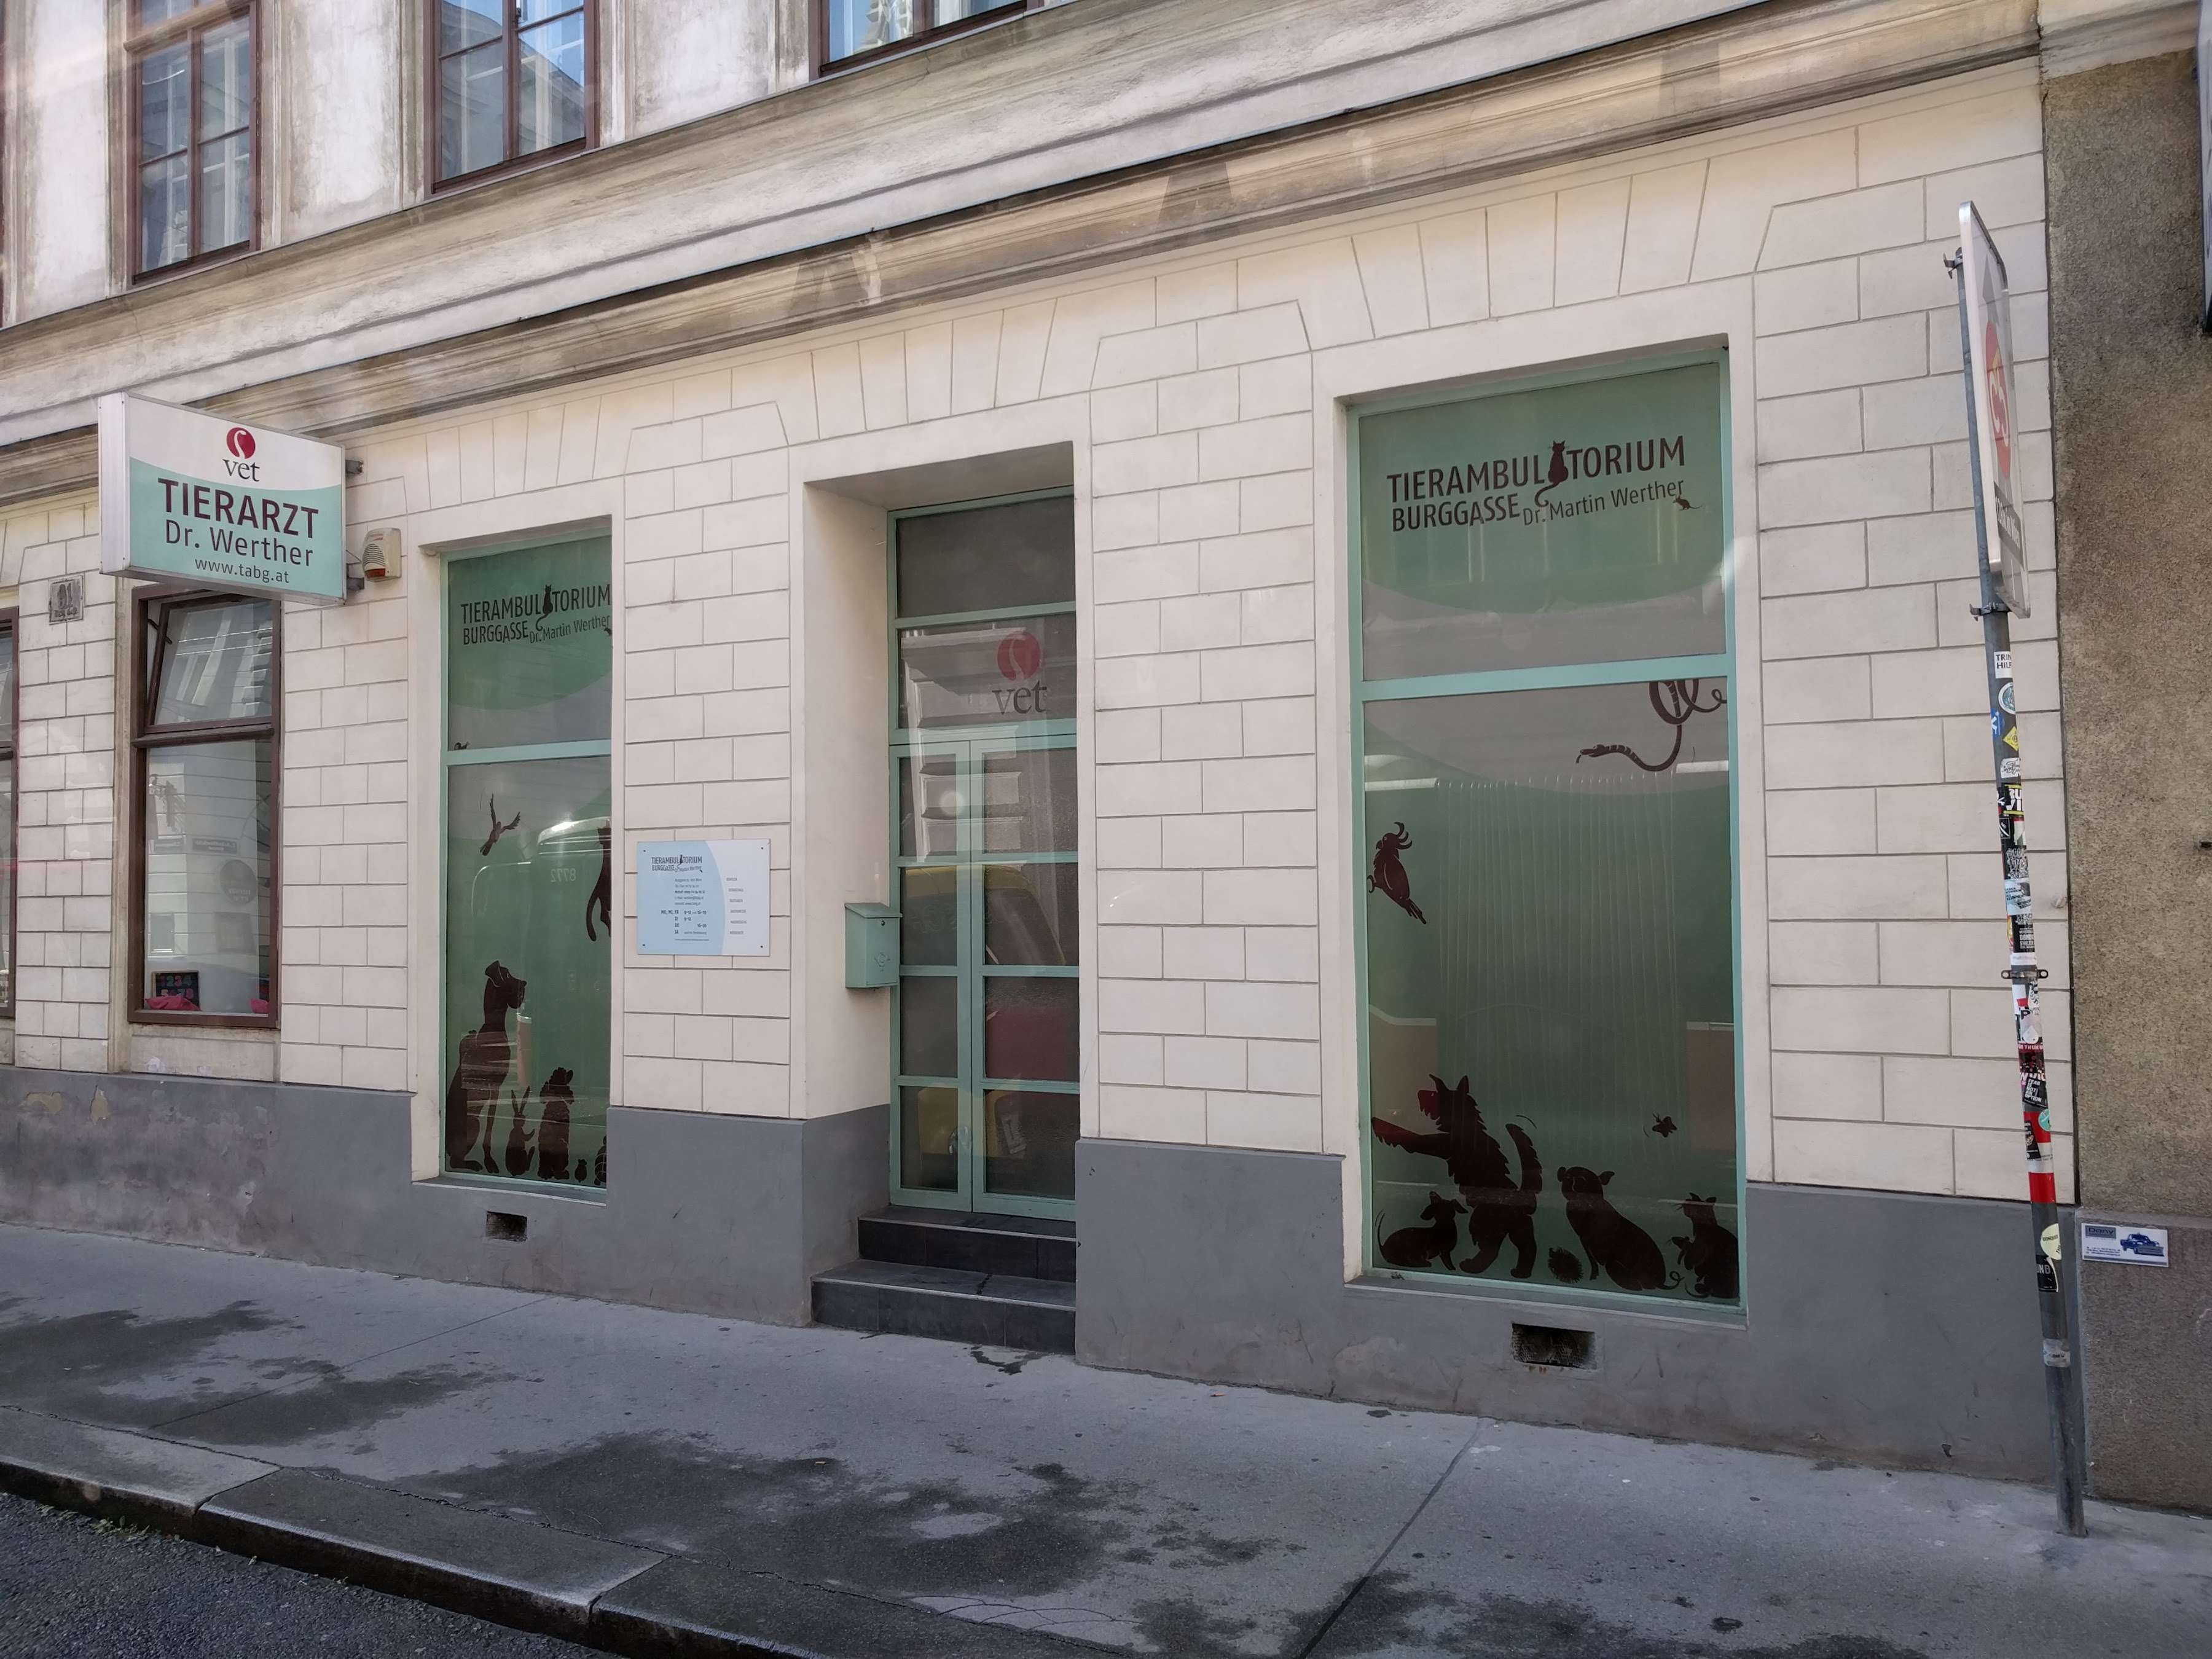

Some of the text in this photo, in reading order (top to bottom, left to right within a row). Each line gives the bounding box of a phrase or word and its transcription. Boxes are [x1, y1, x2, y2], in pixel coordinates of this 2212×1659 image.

[222, 458, 261, 482] vet
[158, 477, 319, 539] TIERARZT
[1392, 479, 1684, 532] BURGGASSE Dr. Martin Werther
[165, 519, 314, 567] Dr. Werther
[194, 559, 290, 584] www.tabg.at
[463, 615, 610, 645] BURGGASSE Dr. Martin Werther
[992, 680, 1048, 716] vet
